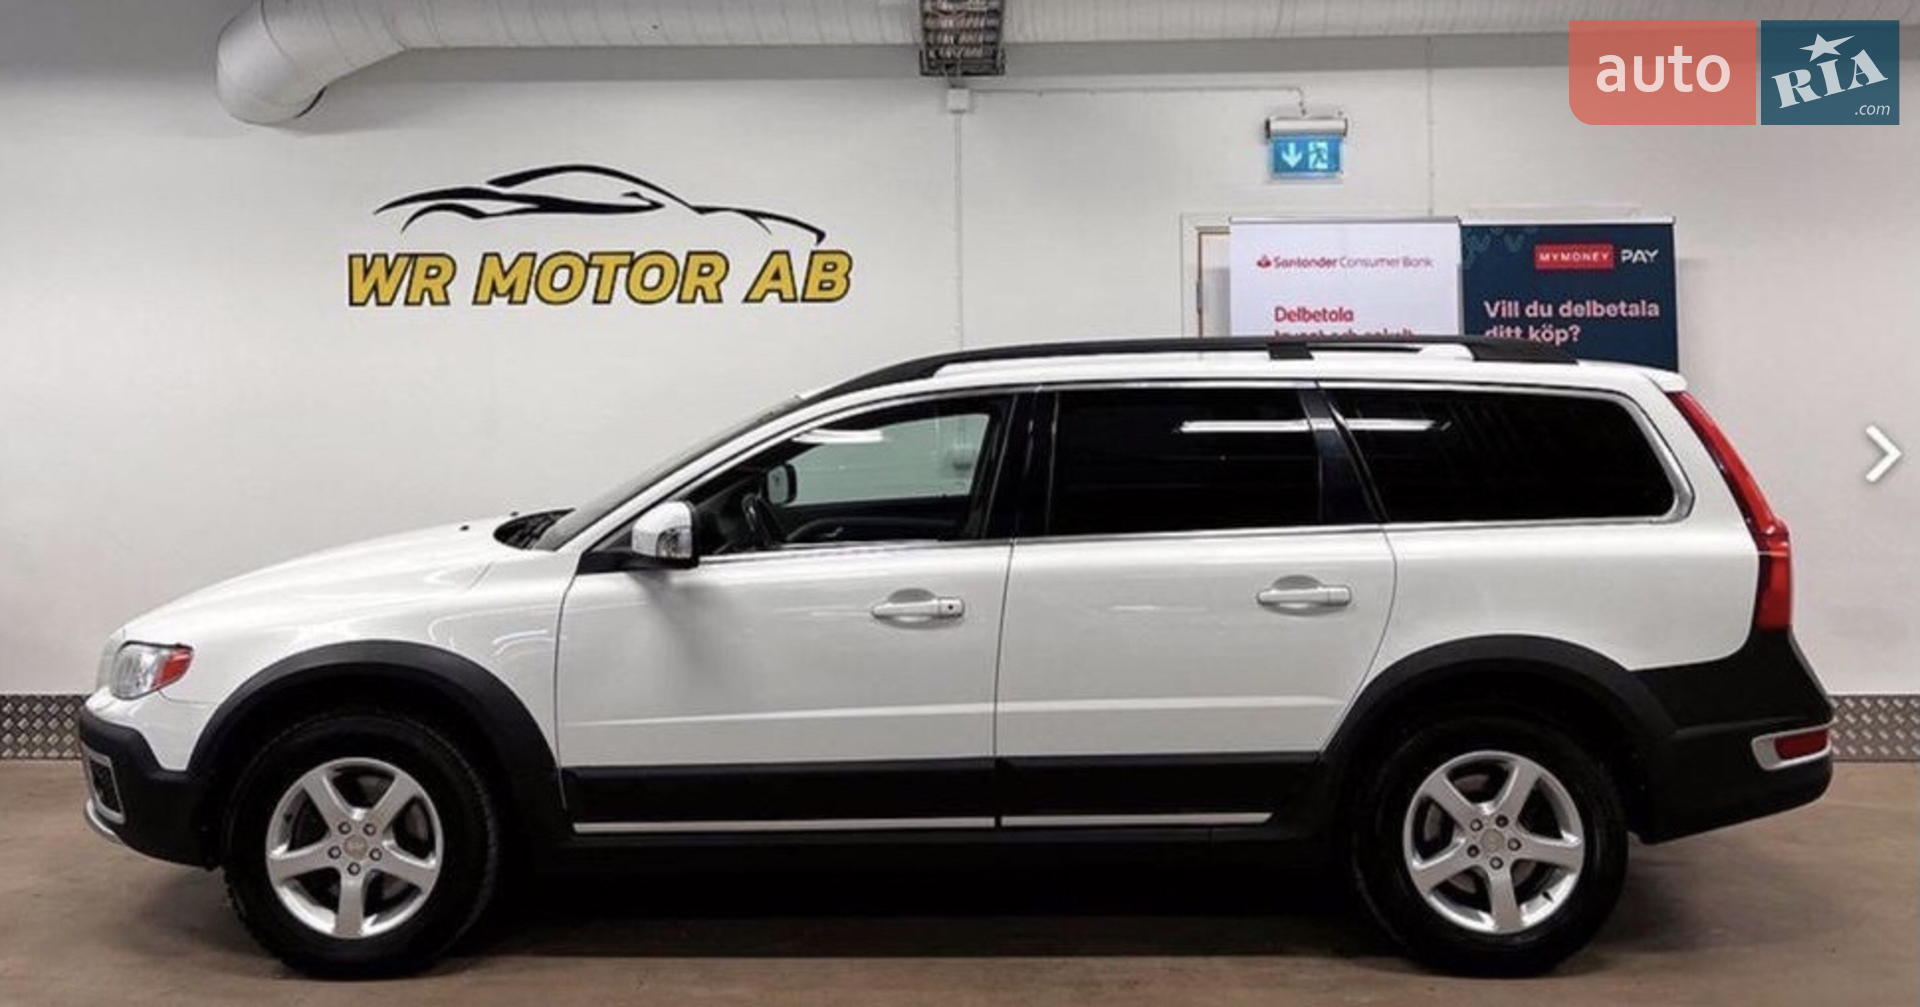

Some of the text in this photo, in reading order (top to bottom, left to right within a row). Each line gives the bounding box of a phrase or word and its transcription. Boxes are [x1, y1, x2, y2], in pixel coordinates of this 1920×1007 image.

[1274, 256, 1433, 268] Santander Consumer Bank
[1539, 249, 1660, 263] MYMONEY PAY
[347, 249, 853, 306] WR MOTOR AB
[1274, 305, 1355, 323] Delbetala
[1484, 300, 1661, 318] Vill du delbetala
[1528, 323, 1581, 345] köp?
